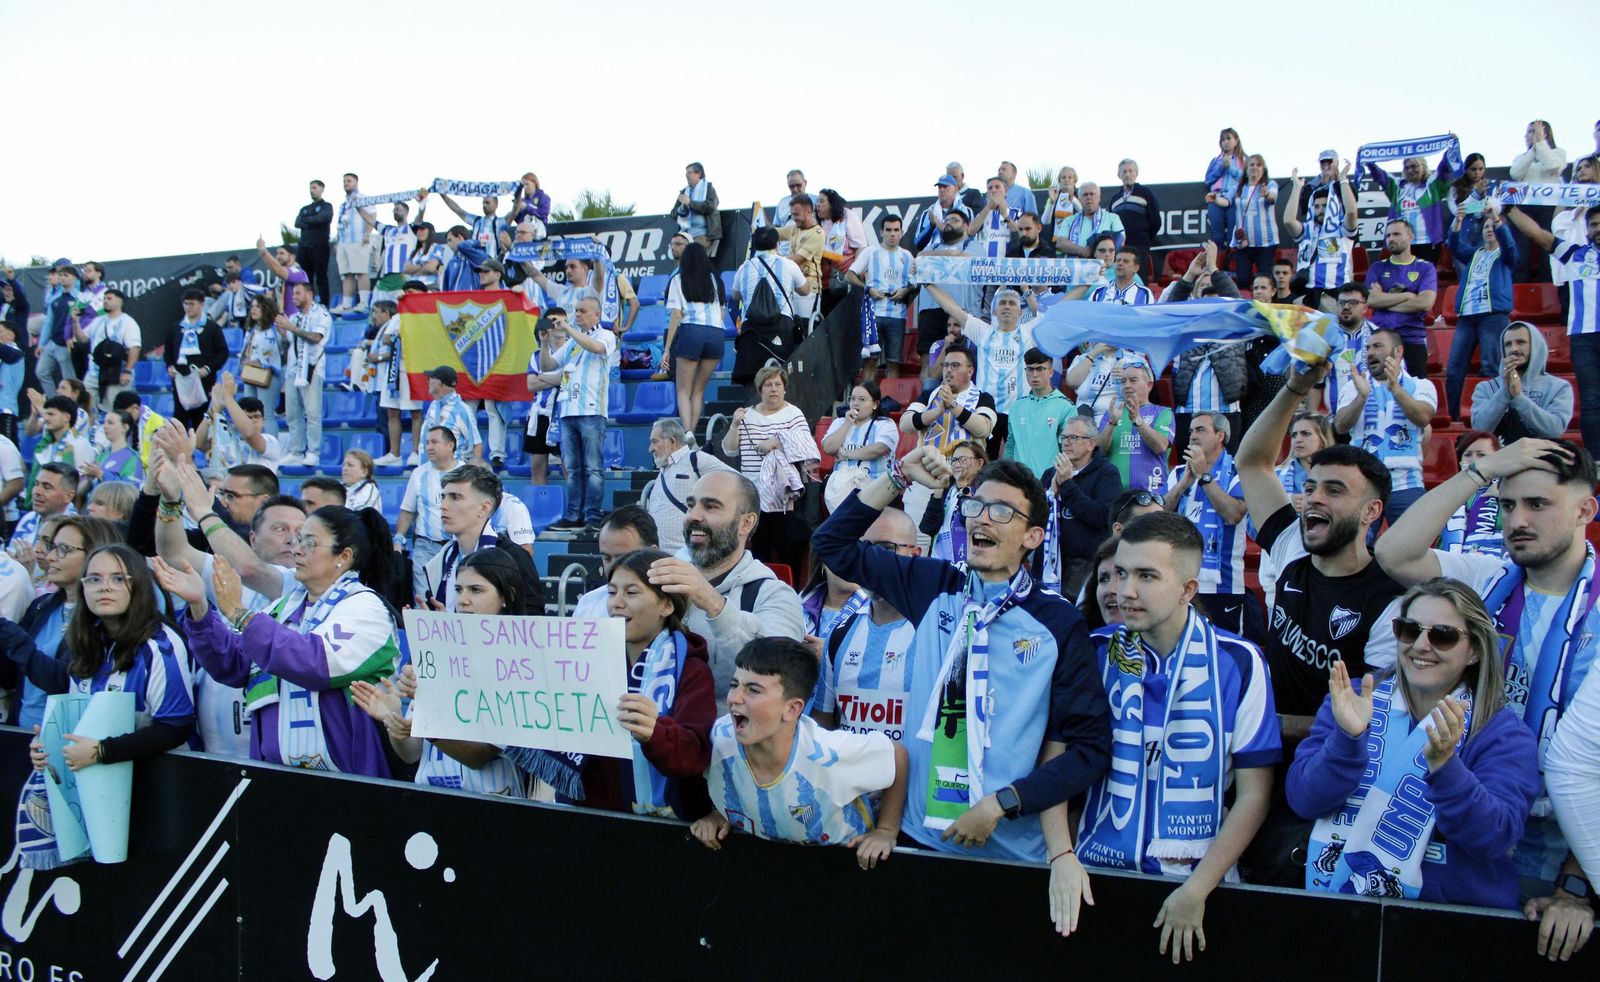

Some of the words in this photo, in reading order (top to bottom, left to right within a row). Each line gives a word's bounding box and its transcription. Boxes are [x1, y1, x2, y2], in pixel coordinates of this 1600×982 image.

[1402, 146, 1413, 154] TE
[1531, 186, 1554, 197] YO
[1560, 186, 1579, 197] TE
[1586, 186, 1600, 197] D
[971, 265, 1071, 277] MALAGUISTA
[417, 617, 468, 646] DANI
[480, 618, 600, 650] SANCHEZ
[1281, 618, 1342, 673] UNESCO
[417, 650, 437, 680] 18
[449, 655, 472, 679] ME
[496, 656, 536, 682] DAS
[555, 659, 591, 682] TU
[454, 688, 615, 736] CAMISETA
[838, 694, 904, 726] Tivoli
[884, 728, 905, 741] SO
[1167, 814, 1212, 825] TANTO
[1167, 825, 1212, 836] MONTA
[1091, 841, 1125, 860] TANTO
[1083, 851, 1126, 868] MONTA
